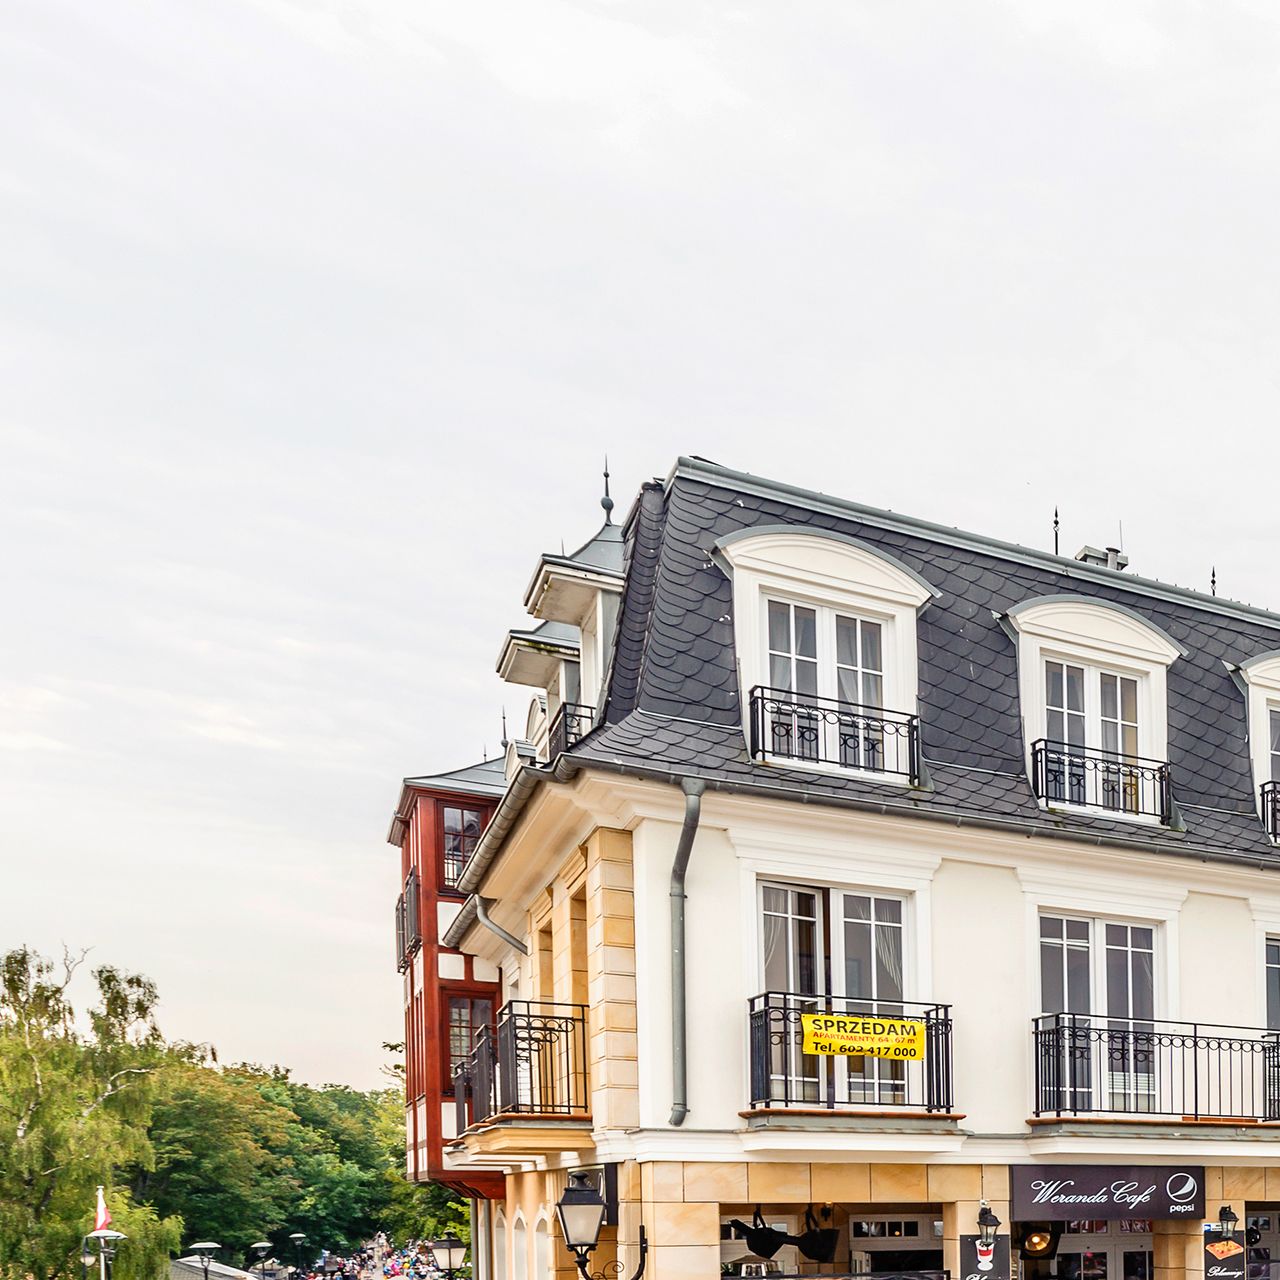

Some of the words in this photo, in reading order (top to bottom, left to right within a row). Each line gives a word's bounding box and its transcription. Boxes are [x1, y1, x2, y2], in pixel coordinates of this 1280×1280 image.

[812, 1018, 917, 1036] SPRZEDAM
[813, 1032, 875, 1043] APARTAMENTY
[813, 1041, 836, 1053] Tel.
[840, 1044, 864, 1053] 602
[866, 1045, 891, 1056] 417
[894, 1047, 917, 1057] 000
[1030, 1180, 1109, 1204] Weranda
[1110, 1180, 1157, 1209] Cafe
[1169, 1203, 1195, 1214] pepsi
